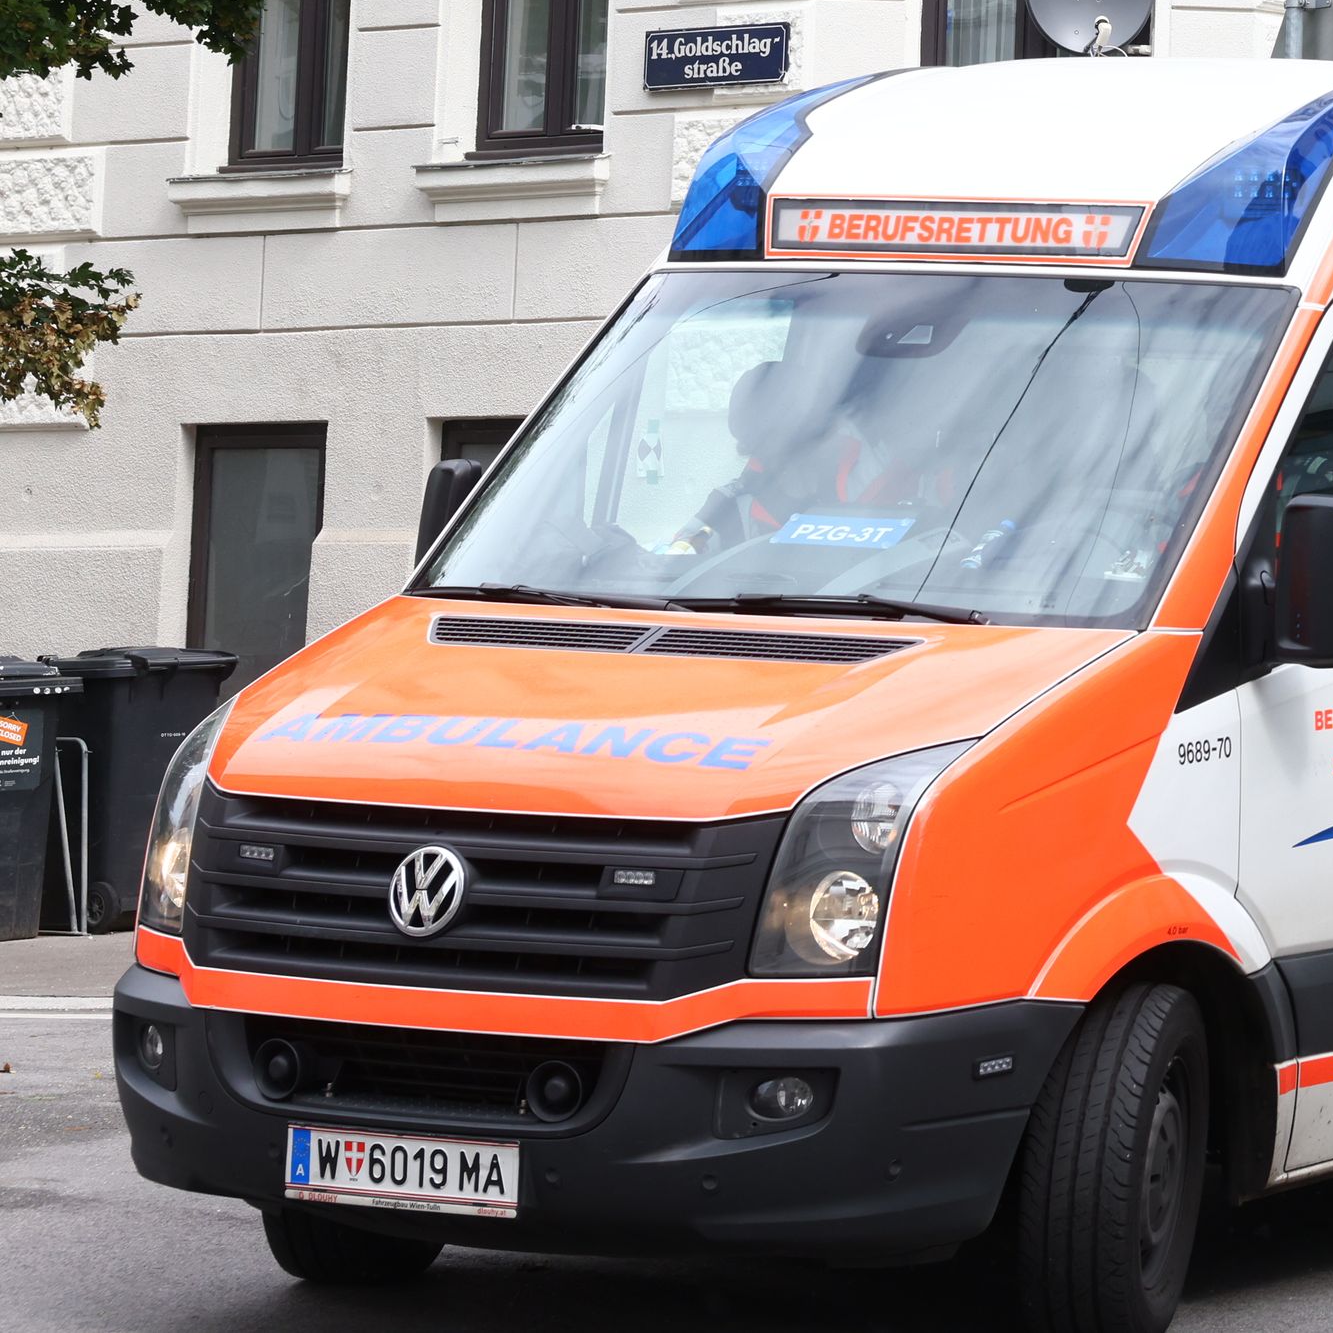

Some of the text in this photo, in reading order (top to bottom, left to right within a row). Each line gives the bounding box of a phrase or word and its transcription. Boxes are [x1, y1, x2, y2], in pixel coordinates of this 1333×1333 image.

[684, 57, 743, 78] straße
[827, 213, 1073, 245] BERUFSRETTUNG
[791, 523, 894, 543] PZG-3T
[256, 713, 775, 771] AMBULANCE
[1178, 736, 1233, 765] 9689-70
[295, 1164, 305, 1176] A
[318, 1138, 505, 1194] W 6019 MA
[372, 1198, 409, 1210] Fahrzeugbau
